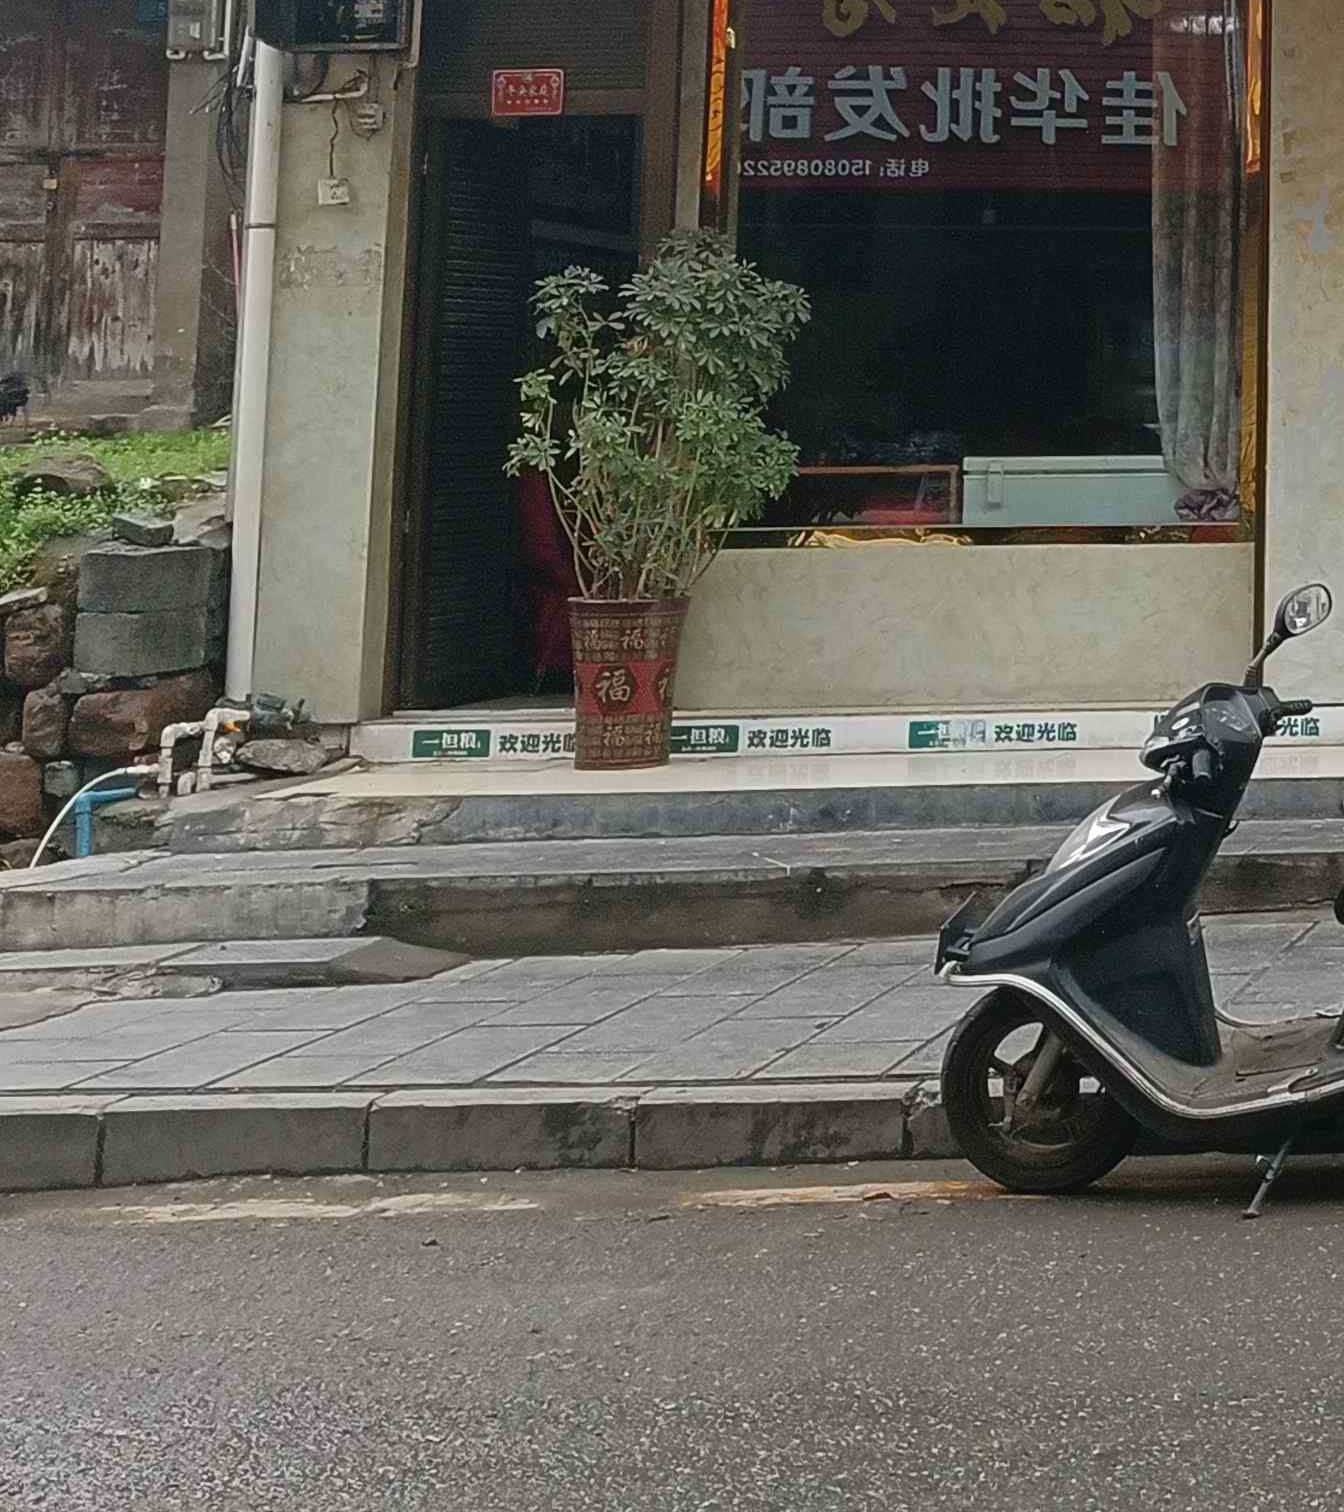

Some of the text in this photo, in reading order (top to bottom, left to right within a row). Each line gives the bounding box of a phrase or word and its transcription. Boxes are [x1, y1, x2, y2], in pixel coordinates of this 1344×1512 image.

[595, 668, 631, 703] 福
[994, 721, 1078, 743] 欢迎光临
[1279, 716, 1320, 737] 光临
[747, 727, 832, 749] 欢迎光临
